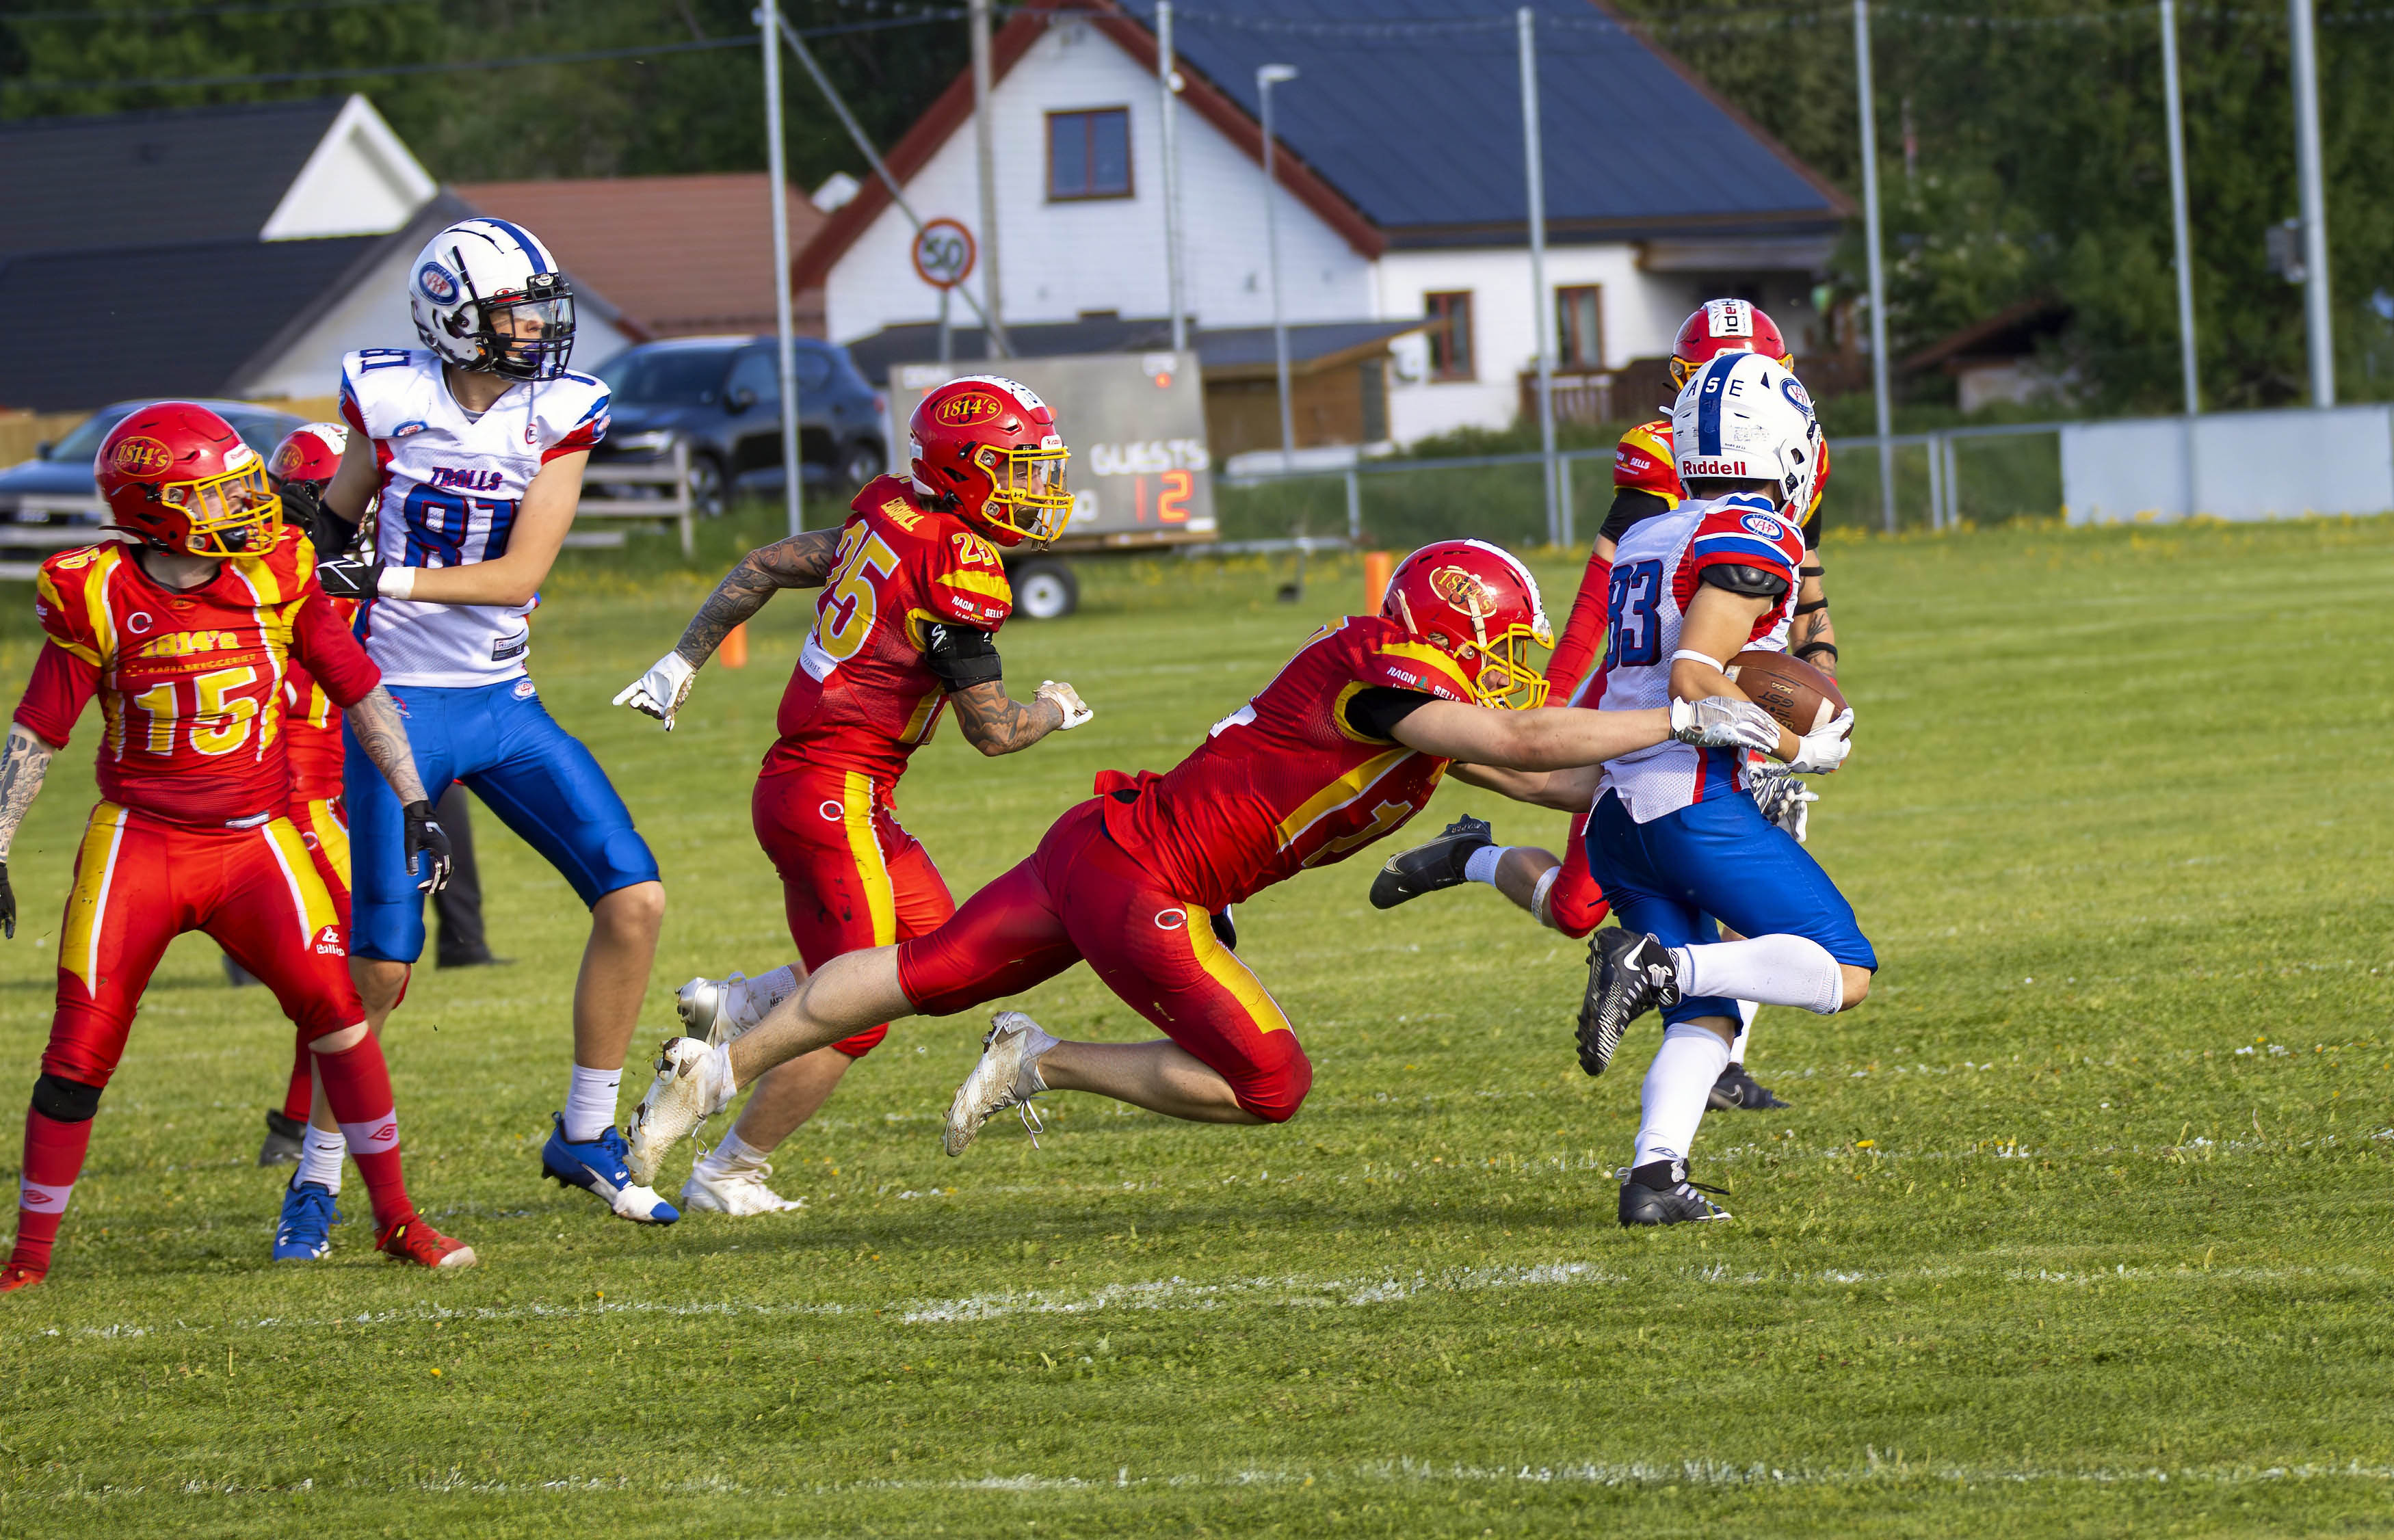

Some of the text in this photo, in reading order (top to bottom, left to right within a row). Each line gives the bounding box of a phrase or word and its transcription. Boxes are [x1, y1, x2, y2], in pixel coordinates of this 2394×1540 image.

[925, 237, 963, 269] 50
[942, 398, 998, 419] 1814's
[1090, 439, 1210, 476] GUESTS
[1683, 460, 1747, 476] Riddell
[430, 469, 503, 491] TROLLS
[1135, 469, 1194, 525] 12
[951, 532, 995, 566] 25
[812, 518, 901, 662] 25
[1606, 558, 1663, 674] 83
[133, 666, 259, 756] 15
